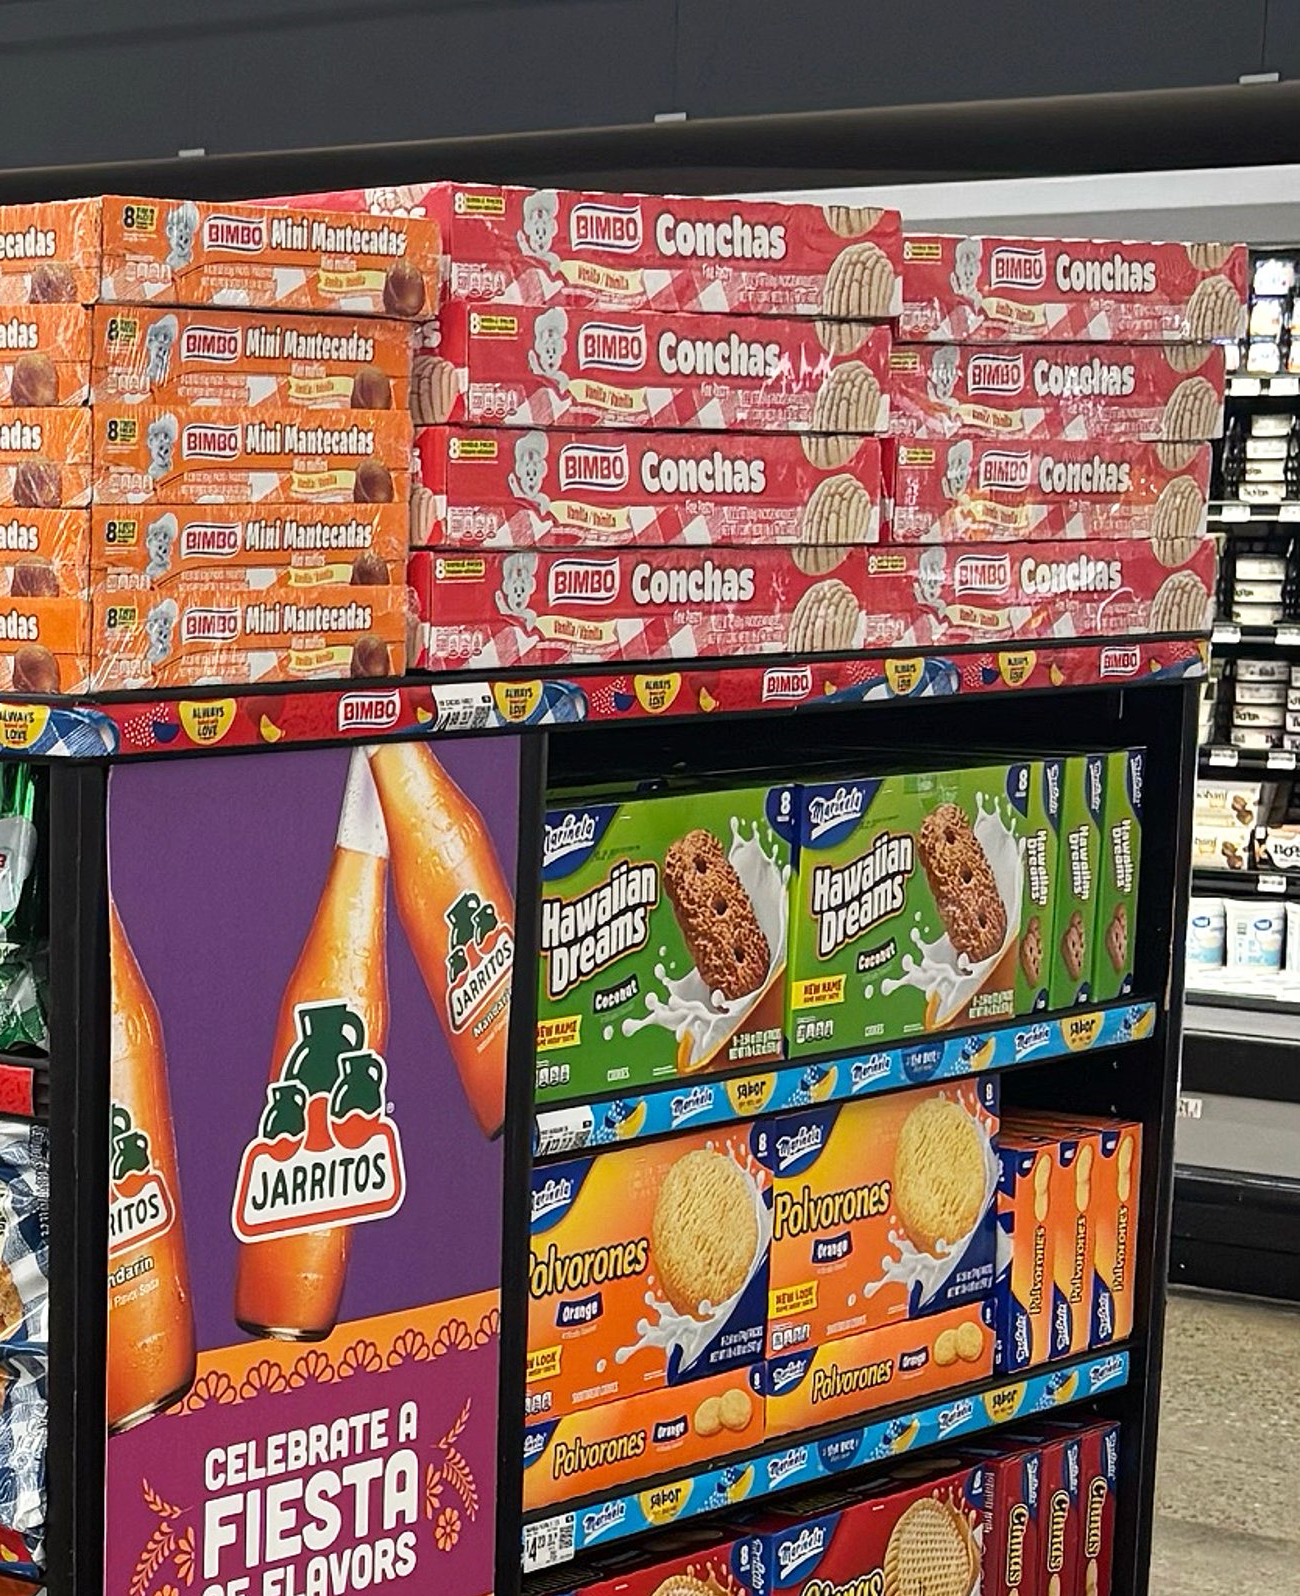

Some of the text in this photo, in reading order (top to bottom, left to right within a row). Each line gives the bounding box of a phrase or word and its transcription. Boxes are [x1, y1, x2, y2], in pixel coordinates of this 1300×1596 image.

[207, 224, 263, 249] BIMBO
[269, 218, 407, 256] Mini Mantecadas
[575, 213, 638, 243] BIMBO
[656, 213, 785, 260] Conchas
[995, 258, 1043, 280] BIMBO
[1056, 255, 1156, 293] Conchas
[583, 333, 643, 361] BIMBO
[659, 331, 780, 378] Conchas
[186, 430, 238, 453] BIMBO
[246, 423, 374, 456] Mini Mantecadas
[553, 565, 614, 594] BIMBO
[632, 562, 754, 604] Conchas
[186, 612, 238, 635] BIMBO
[246, 601, 371, 634] Mini Mantecadas
[344, 701, 396, 721] BIMBO
[5, 730, 28, 742] LOVE
[1018, 768, 1027, 789] 8
[781, 791, 790, 814] 8
[813, 834, 912, 913] Hawaiian
[542, 865, 656, 949] Hawaiian
[820, 876, 903, 955] Dreams
[552, 907, 646, 995] Dreams
[858, 943, 896, 970] Coconut
[456, 941, 512, 1016] JARRITOS
[595, 980, 638, 1010] Coconut
[252, 1152, 386, 1210] JARRITOS
[774, 1182, 891, 1238] Polvorones
[1071, 1216, 1086, 1303] Polvorones
[562, 1302, 599, 1323] Orange
[813, 1361, 891, 1402] Polvorones
[204, 1401, 418, 1490] CELEBRATE A
[553, 1432, 645, 1478] Polvorones
[204, 1449, 418, 1580] FIESTA
